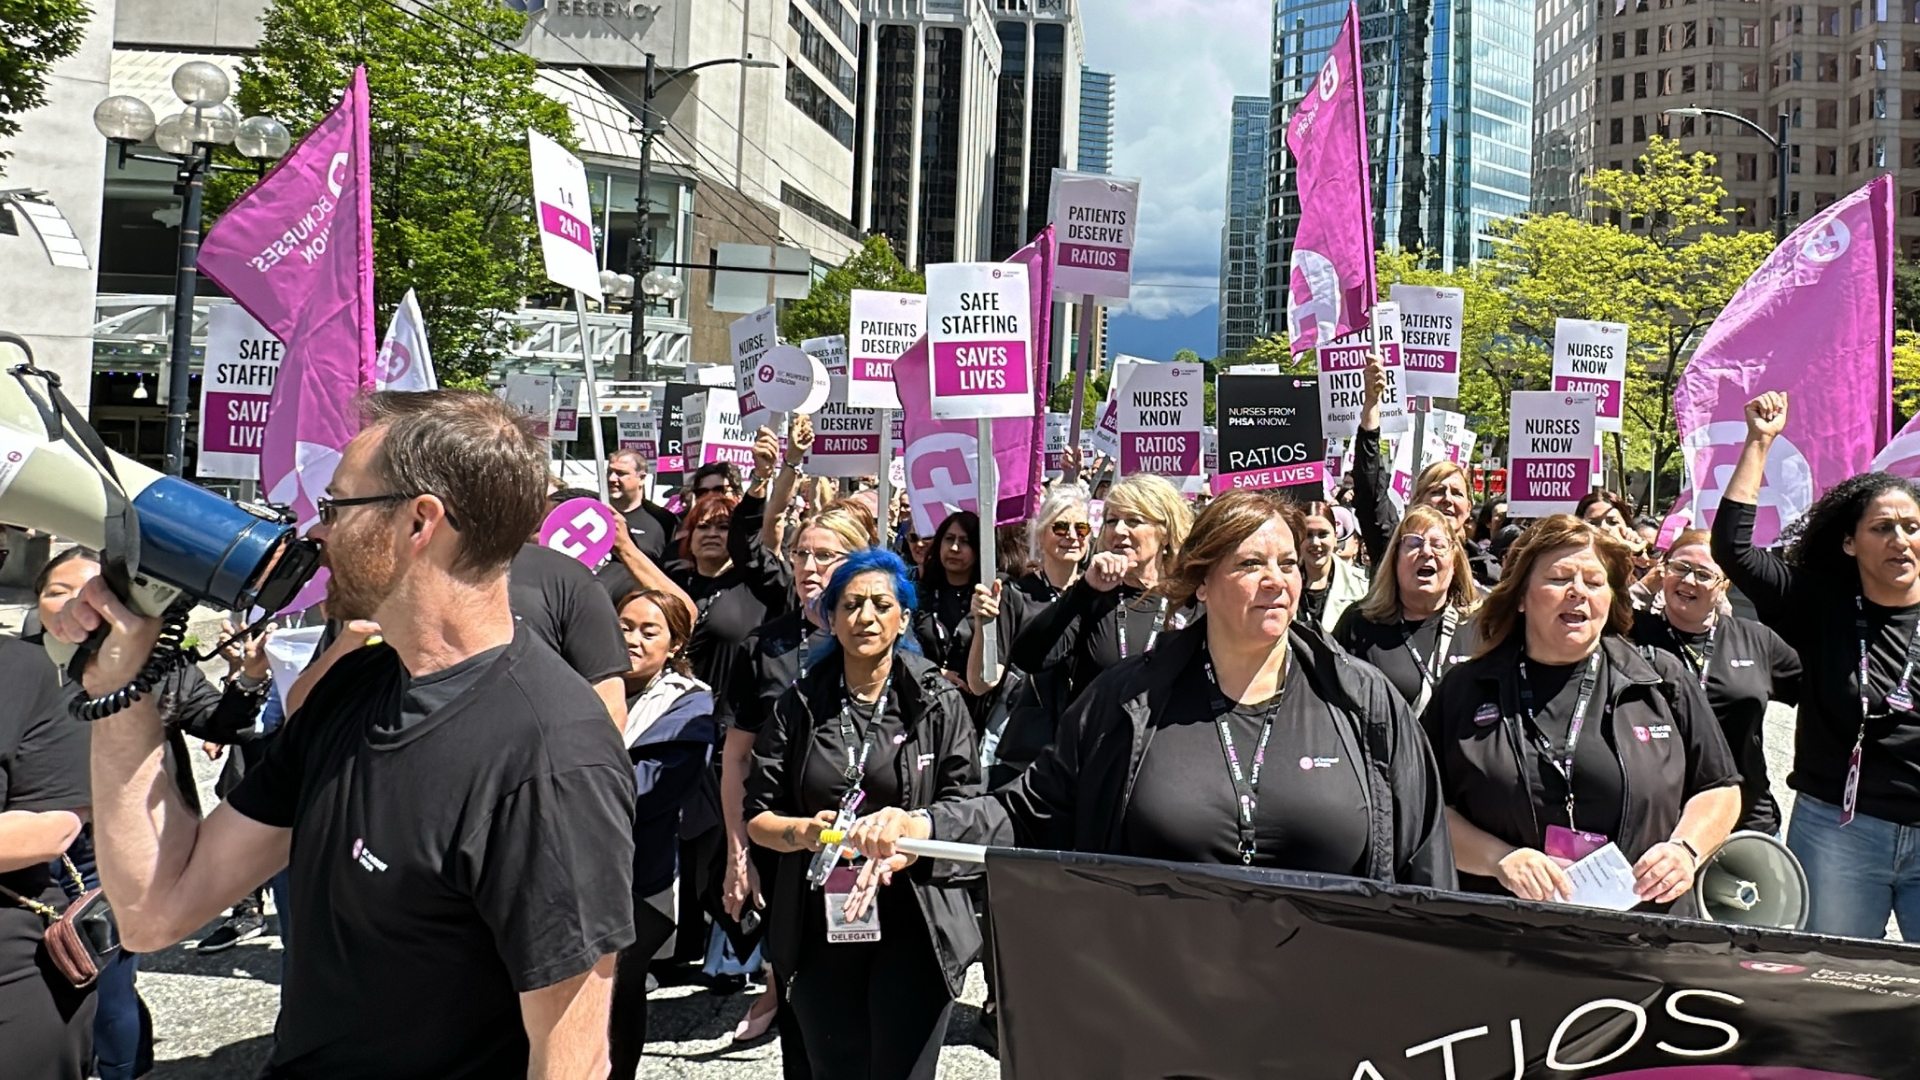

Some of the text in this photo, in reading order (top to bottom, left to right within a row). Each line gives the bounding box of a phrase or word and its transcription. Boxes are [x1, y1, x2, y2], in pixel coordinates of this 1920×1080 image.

[1069, 205, 1127, 225] PATIENTS
[1069, 224, 1124, 243] DESERVE
[1071, 248, 1117, 266] RATIOS
[960, 292, 1000, 311] SAFE
[861, 320, 917, 337] PATIENTS
[941, 315, 1018, 334] STAFFING
[1400, 313, 1453, 329] PATIENTS
[239, 338, 280, 361] SAFE
[955, 346, 1008, 367] SAVES
[1567, 343, 1614, 359] NURSES
[217, 363, 276, 387] STAFFI
[865, 362, 894, 378] RATI
[1571, 359, 1607, 375] KNOW
[960, 369, 1006, 390] LIVES
[1330, 371, 1362, 390] INTO
[1566, 380, 1610, 397] RATIOS
[1133, 391, 1188, 407] NURSES
[228, 399, 269, 423] SAVE
[1140, 410, 1181, 426] KNOW
[1228, 407, 1296, 415] NURSES FROM
[821, 418, 873, 430] DESERVE
[1228, 418, 1254, 426] PHSA
[1525, 419, 1580, 434] NURSES
[229, 425, 264, 448] LIVE
[825, 438, 868, 451] RATIOS
[1135, 436, 1186, 453] RATIOS
[1531, 438, 1572, 453] KNOW
[716, 447, 755, 464] RATIO
[1139, 455, 1182, 471] WORK
[1229, 442, 1307, 470] RATIOS
[1233, 466, 1315, 488] SAVE LIVES
[1526, 463, 1575, 479] RATIOS
[1529, 481, 1571, 497] WORK
[831, 933, 877, 941] DELEGATE
